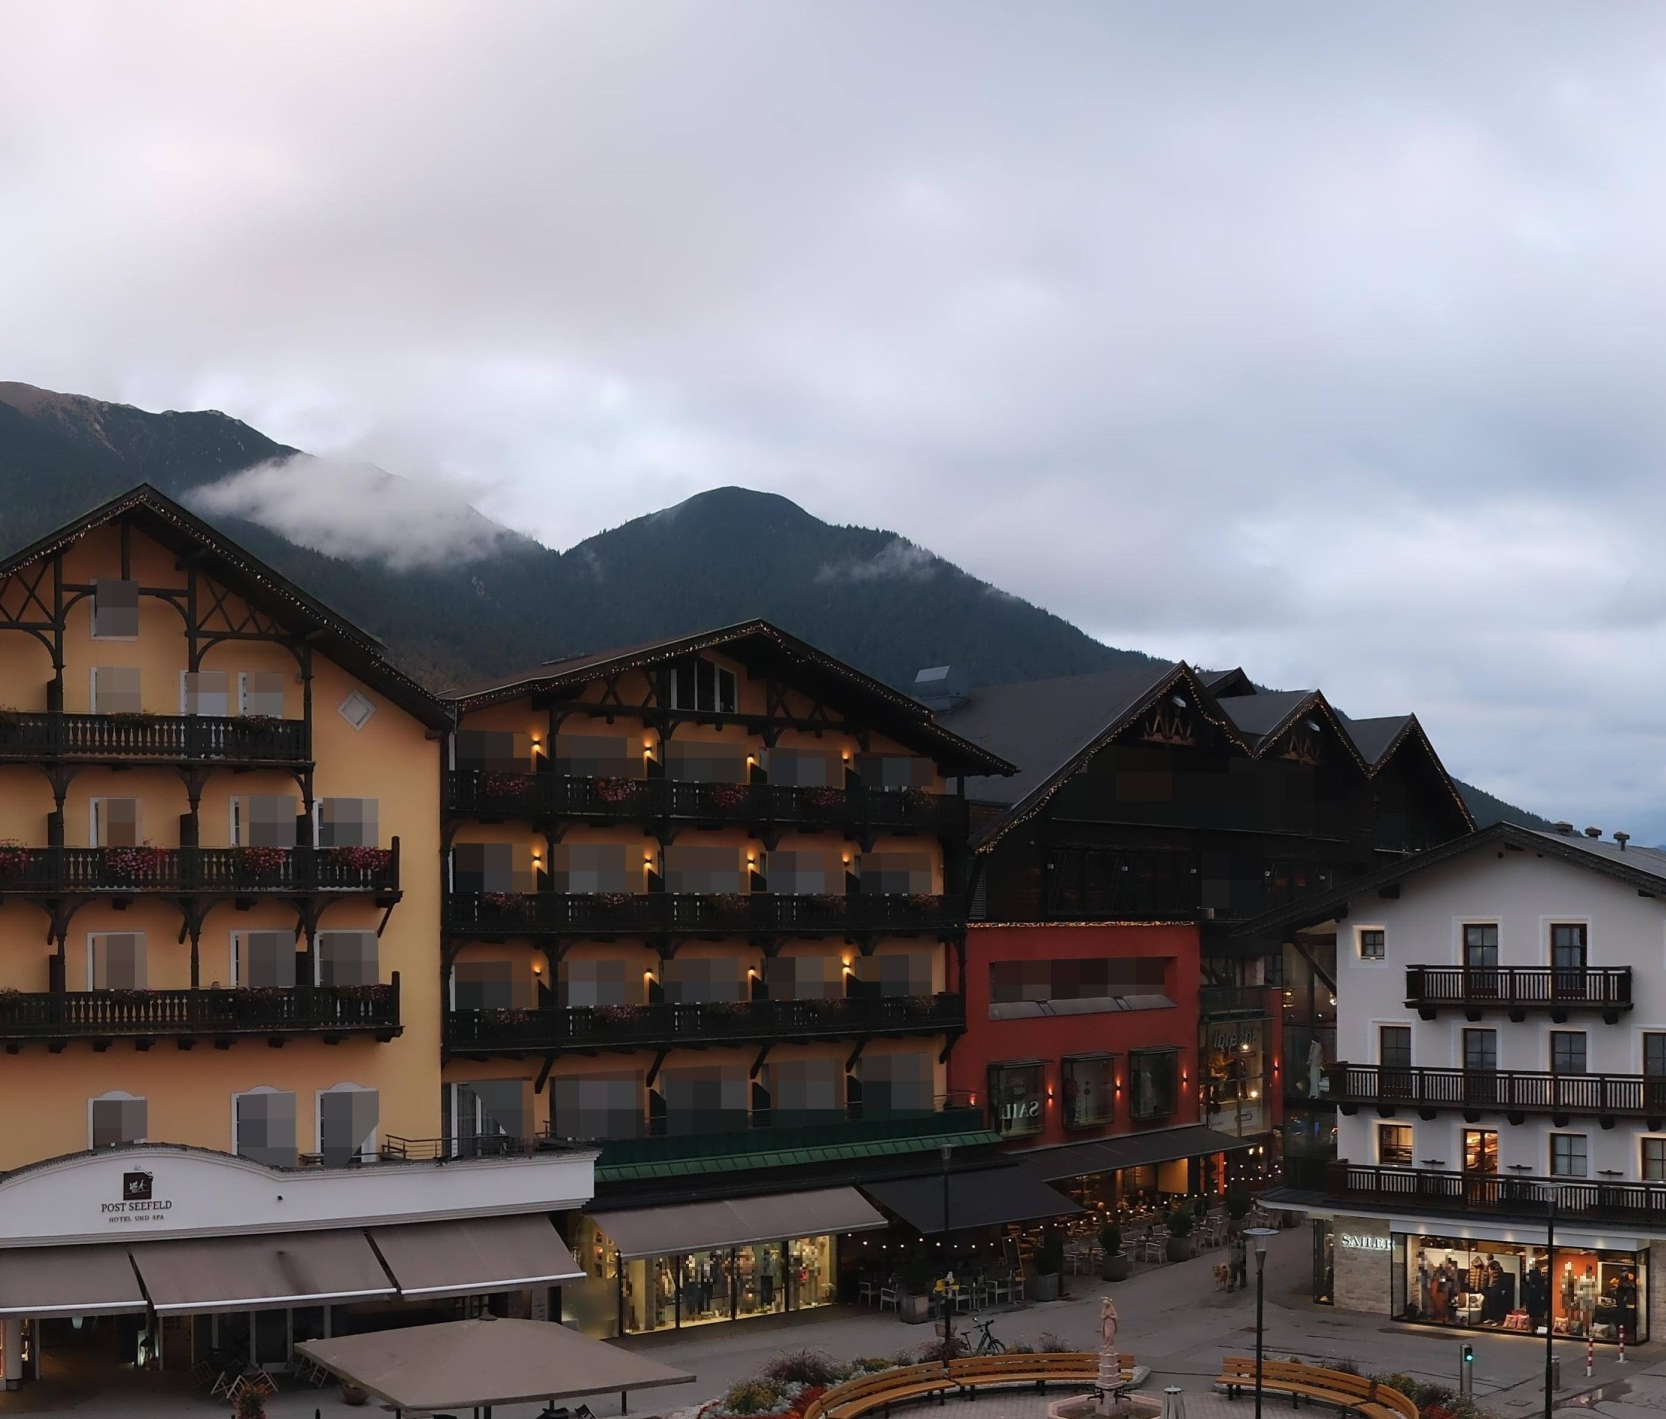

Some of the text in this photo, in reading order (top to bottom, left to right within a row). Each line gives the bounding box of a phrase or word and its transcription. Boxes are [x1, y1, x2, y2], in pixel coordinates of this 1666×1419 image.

[101, 1201, 173, 1213] POST SEEFELD
[1342, 1233, 1396, 1250] SAILER
